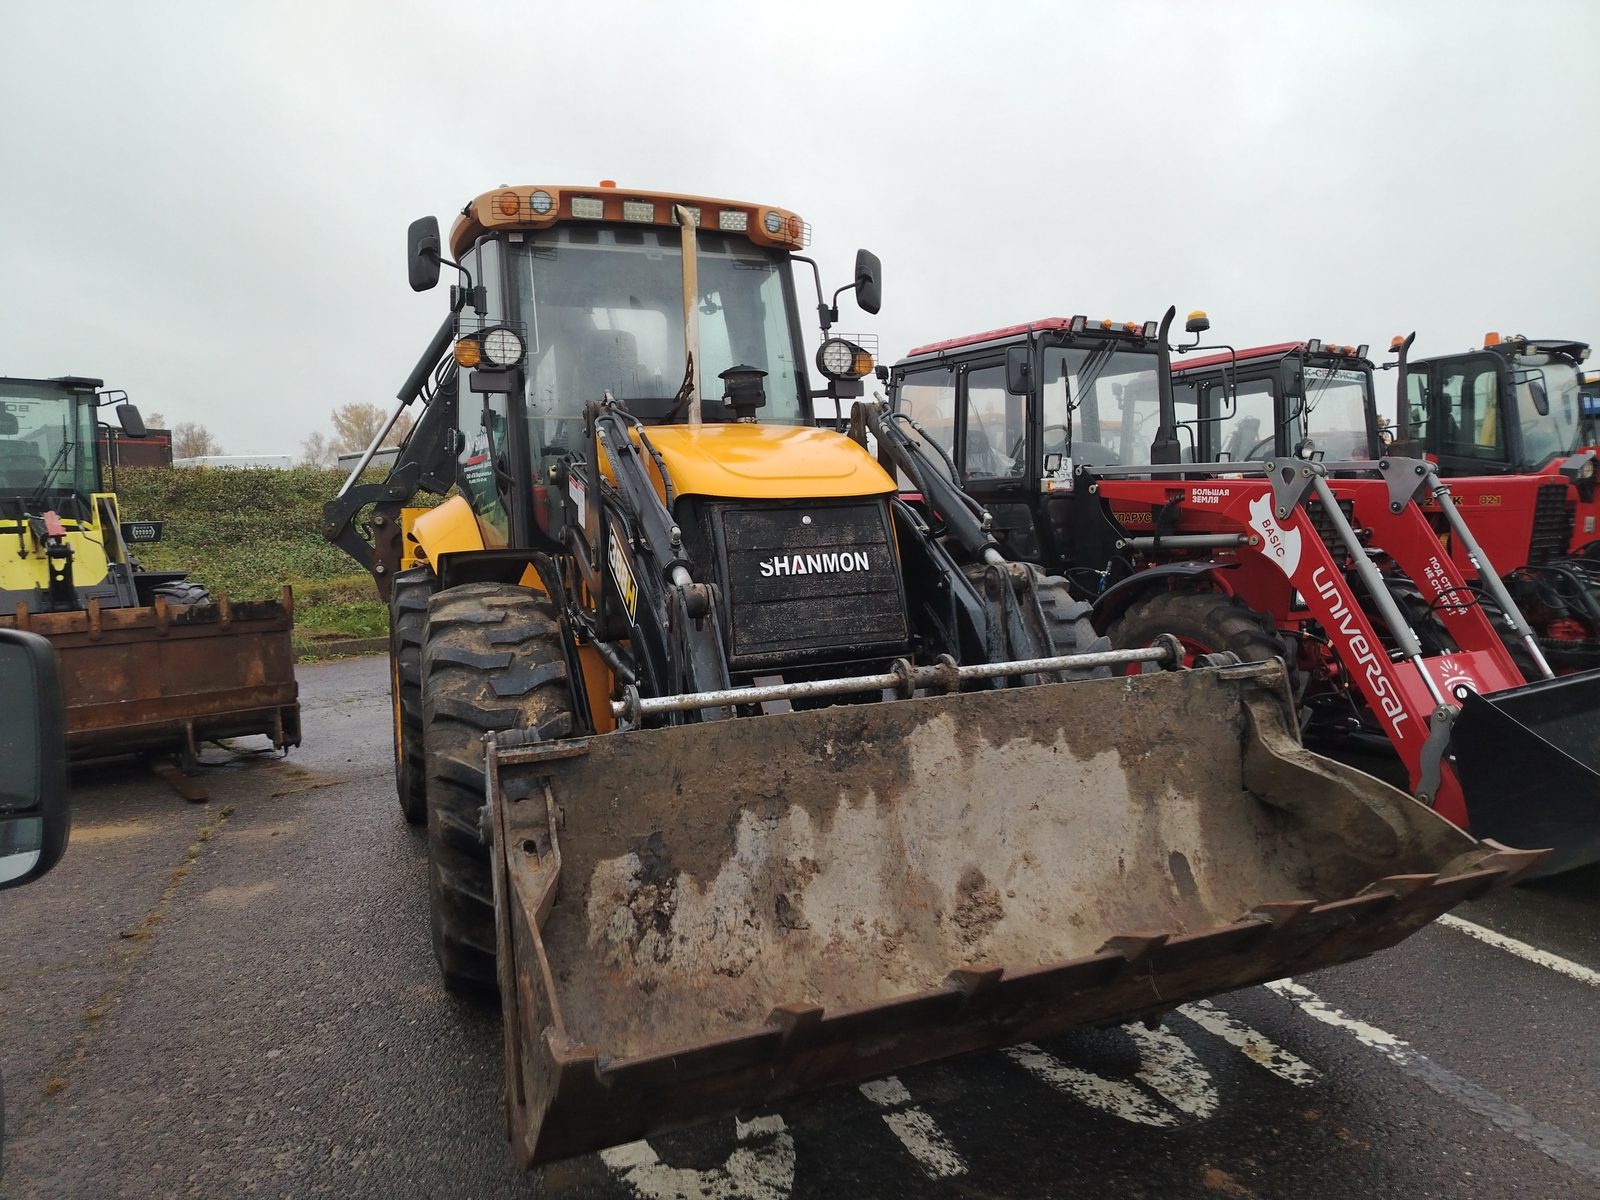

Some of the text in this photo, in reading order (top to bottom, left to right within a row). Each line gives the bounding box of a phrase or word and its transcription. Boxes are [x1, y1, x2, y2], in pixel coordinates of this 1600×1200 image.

[1192, 488, 1230, 497] БОЛЬШАЯ
[1191, 495, 1219, 504] ЗЕМЛЯ
[1112, 512, 1152, 523] ЛАРУС
[1261, 518, 1285, 557] BASIC
[759, 551, 870, 577] SHANMON
[1428, 556, 1445, 577] ПОД
[1423, 566, 1435, 579] НЕ
